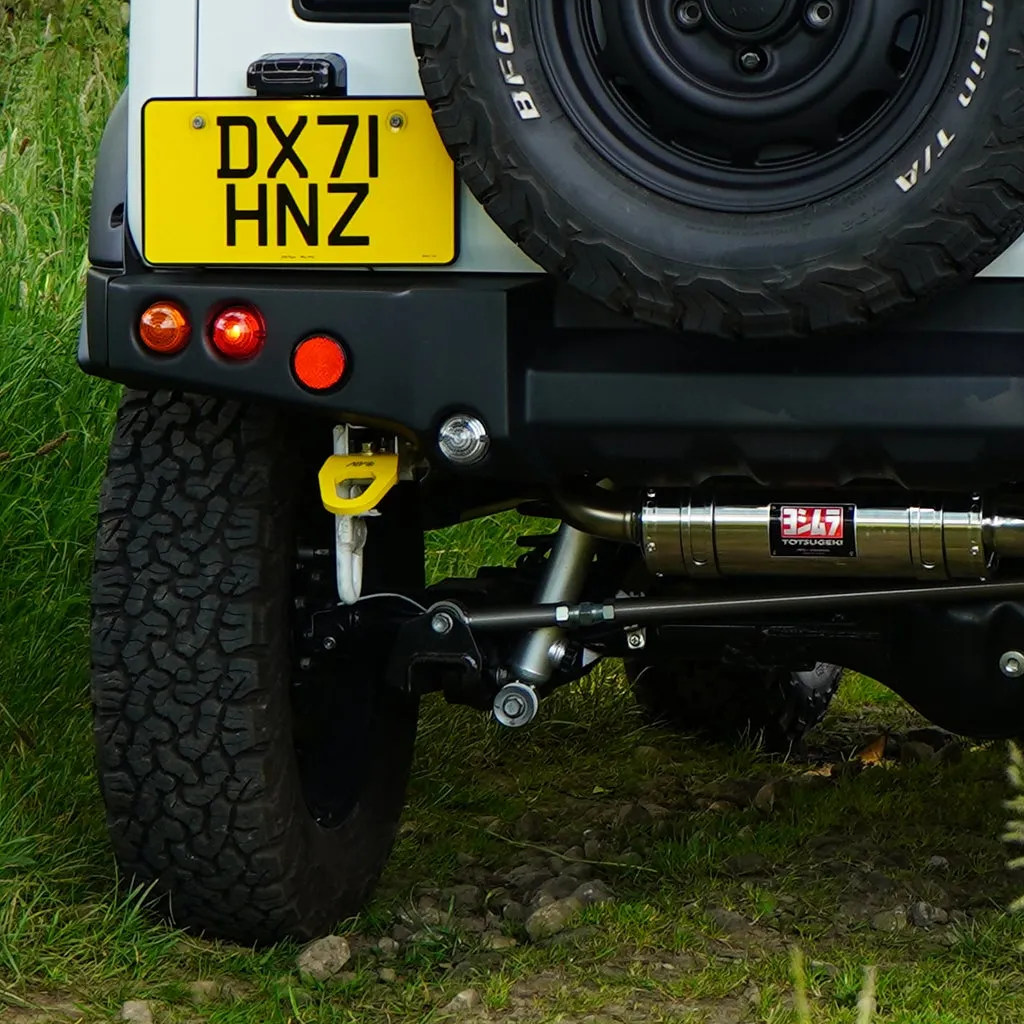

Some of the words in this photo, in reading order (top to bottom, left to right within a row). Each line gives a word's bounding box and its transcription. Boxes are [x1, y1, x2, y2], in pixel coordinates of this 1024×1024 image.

[216, 114, 379, 179] DX71
[895, 129, 955, 193] T/A
[226, 183, 370, 246] HNZ
[783, 508, 841, 536] ヨシムラ
